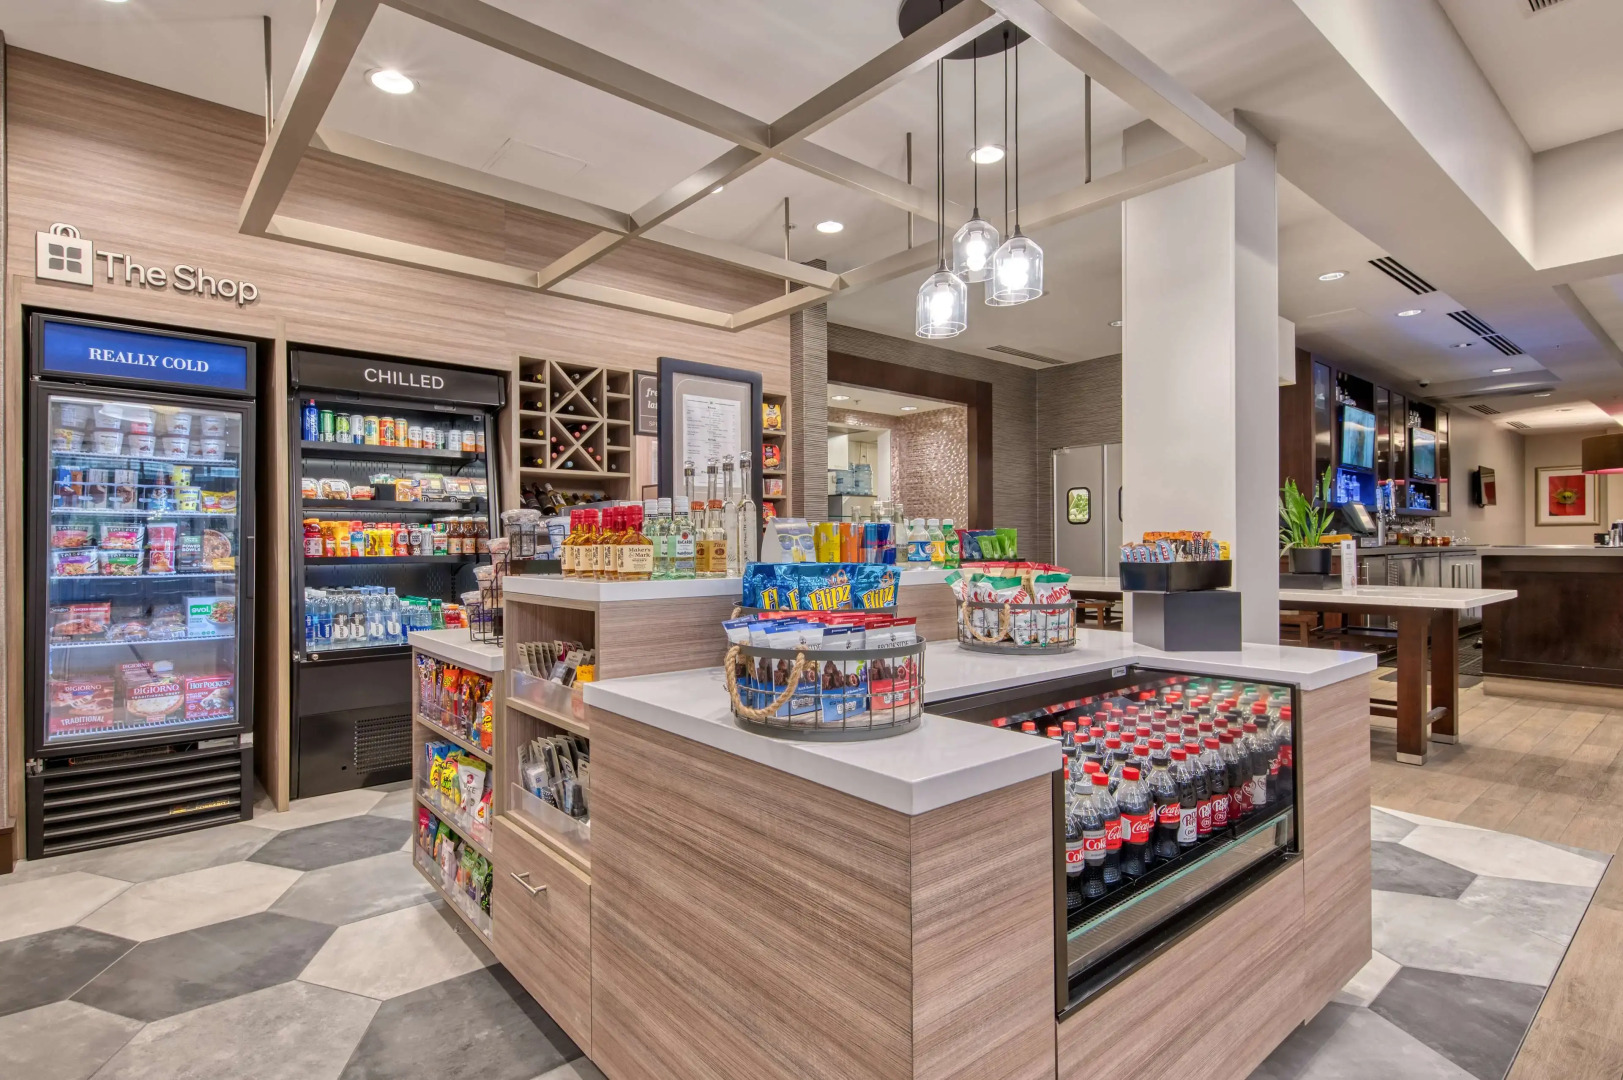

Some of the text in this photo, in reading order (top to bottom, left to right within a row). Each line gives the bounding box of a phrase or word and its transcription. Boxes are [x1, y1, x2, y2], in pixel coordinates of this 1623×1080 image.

[96, 250, 258, 304] The Shop
[88, 347, 209, 373] REALLY COLD
[364, 368, 445, 390] CHILLED
[645, 387, 658, 398] fre
[808, 583, 850, 610] Flipz
[862, 585, 895, 609] Flipz
[133, 684, 180, 696] DIGIORNO
[61, 715, 104, 726] TRADITIONAL
[1086, 837, 1107, 851] Cok
[1067, 850, 1085, 863] Cok
